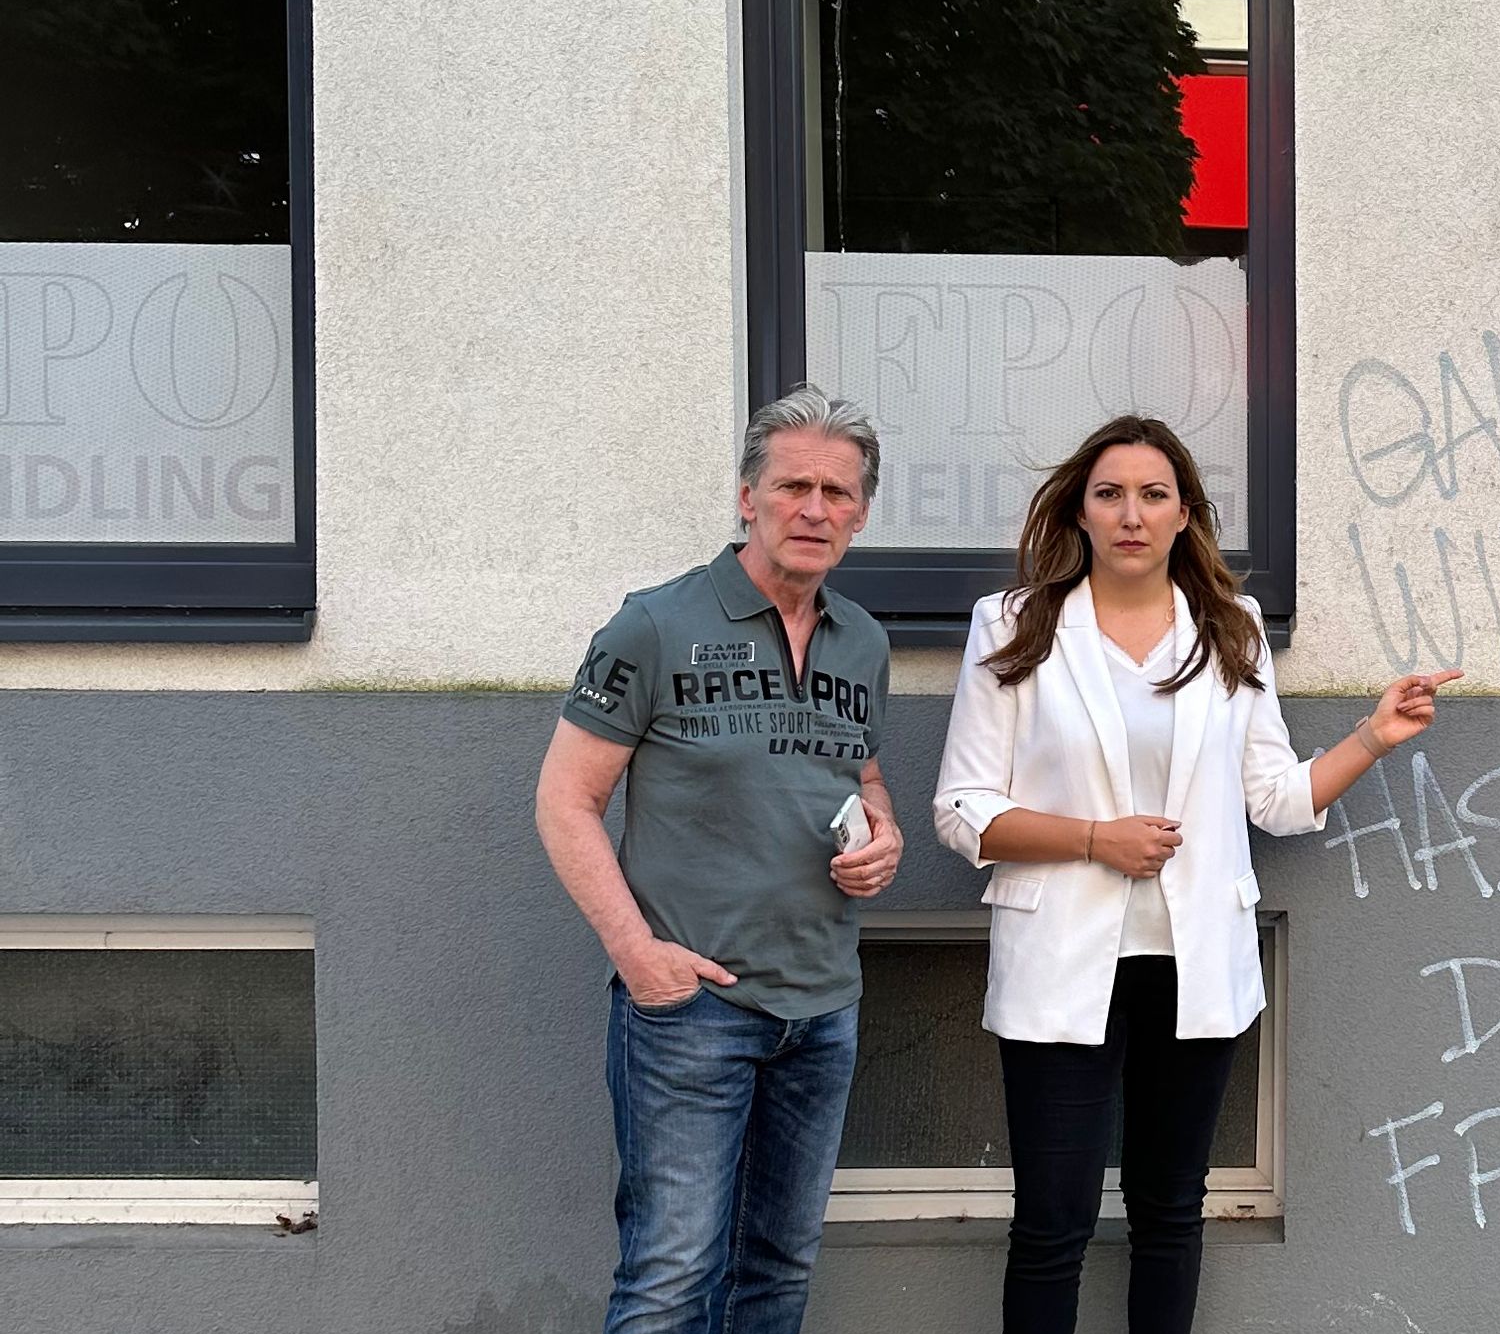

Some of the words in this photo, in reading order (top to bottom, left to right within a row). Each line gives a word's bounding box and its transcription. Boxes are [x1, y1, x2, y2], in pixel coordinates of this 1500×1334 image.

[698, 651, 748, 662] DAVID
[703, 643, 748, 652] CAMP
[672, 669, 785, 706] RACE
[811, 670, 869, 725] PRO
[680, 715, 720, 738] ROAD
[728, 712, 763, 735] BIKE
[769, 711, 812, 734] SPORT
[768, 738, 865, 760] UNLTD
